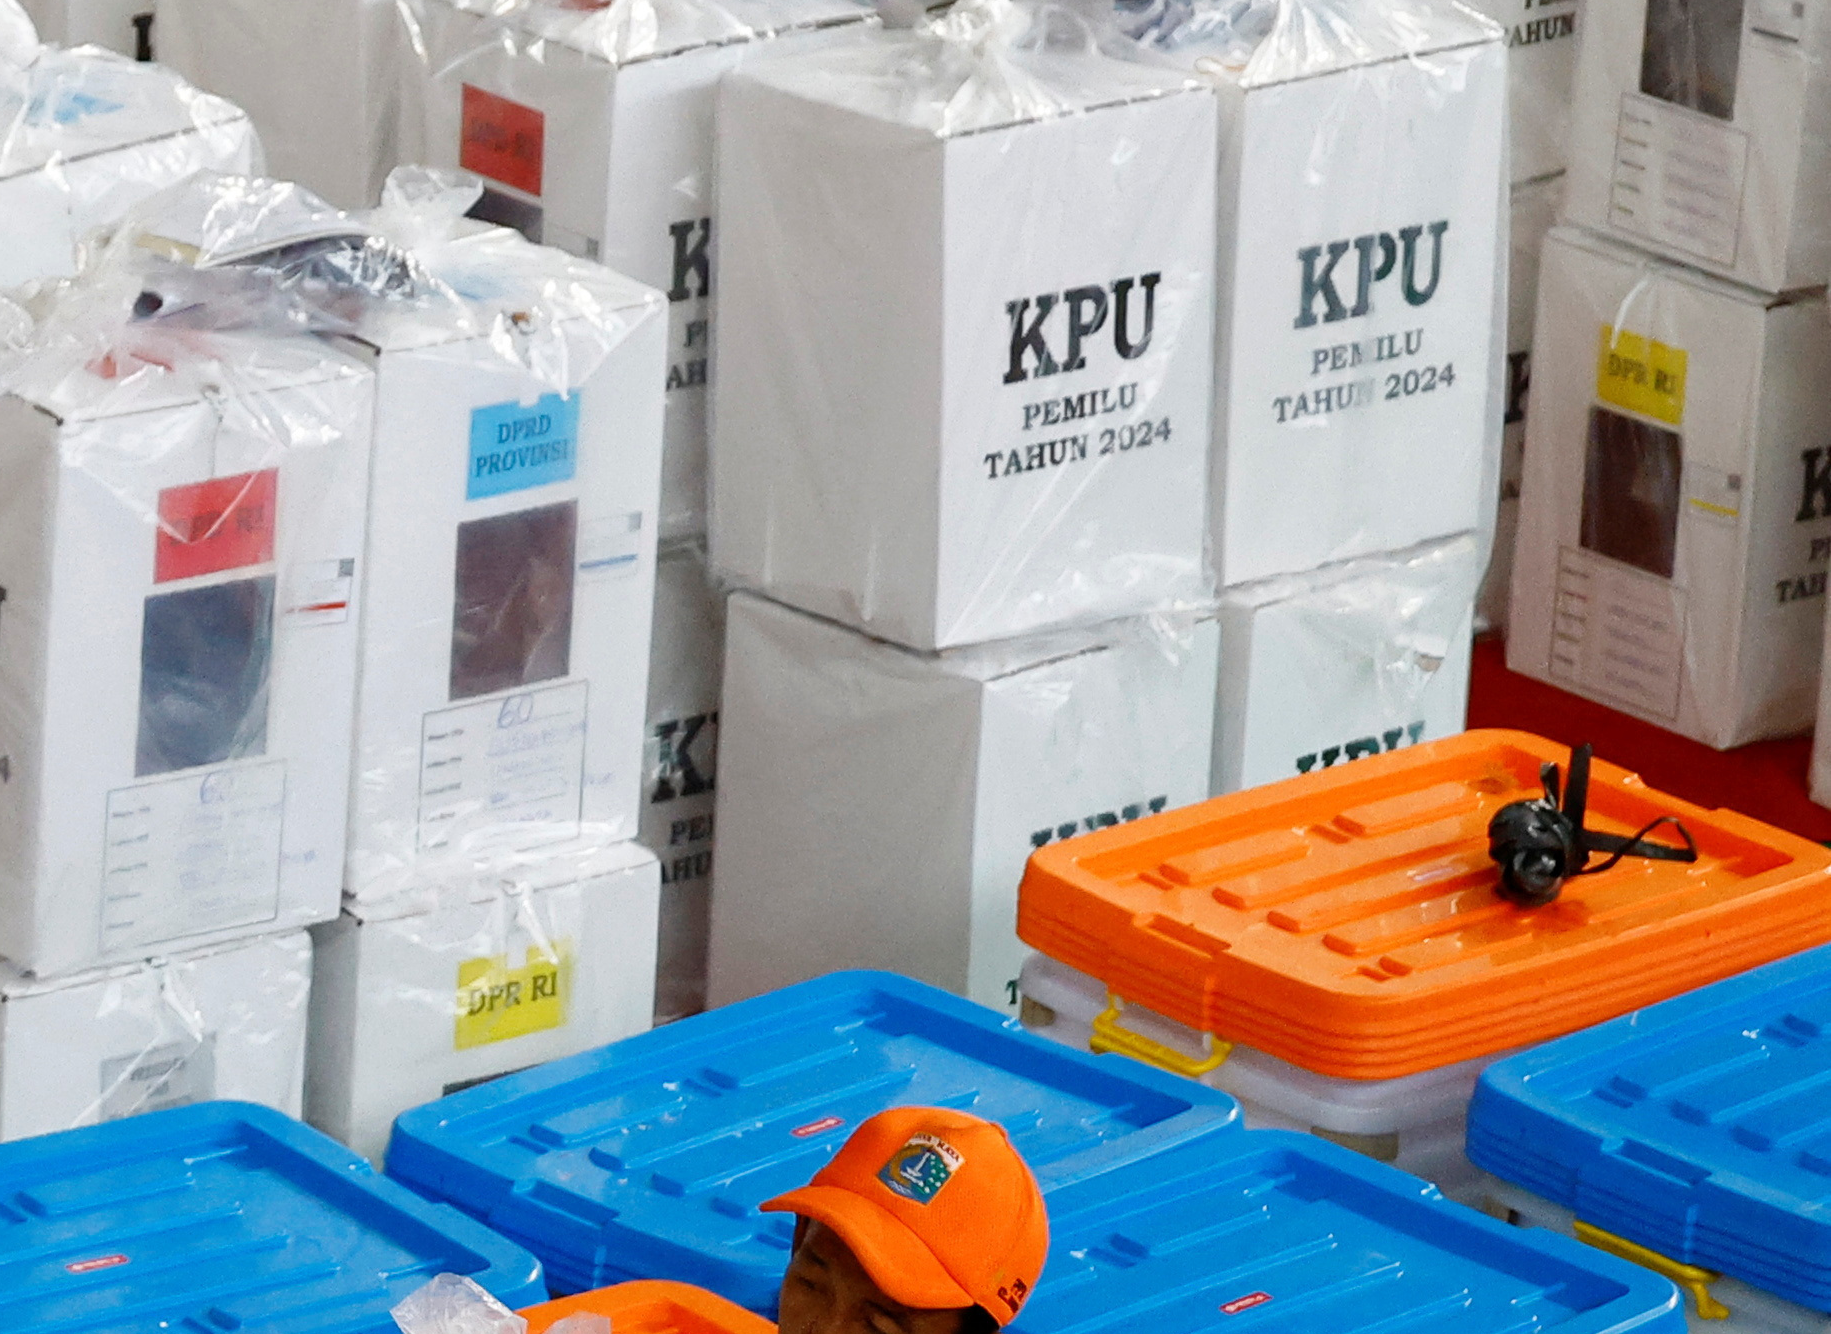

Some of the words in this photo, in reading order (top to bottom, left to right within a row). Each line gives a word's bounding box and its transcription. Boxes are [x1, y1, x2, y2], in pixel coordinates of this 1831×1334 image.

[1507, 13, 1578, 50] AHUN
[1293, 221, 1448, 330] KPU
[1001, 273, 1162, 387] KPU
[1384, 361, 1456, 405] 2024
[497, 412, 552, 445] DPRD
[1022, 381, 1138, 432] PEMILU
[475, 435, 572, 479] PROVINSI
[984, 433, 1090, 482] TAHUN
[1098, 415, 1172, 459] 2024
[468, 981, 521, 1015] DPR
[529, 970, 558, 1002] RI
